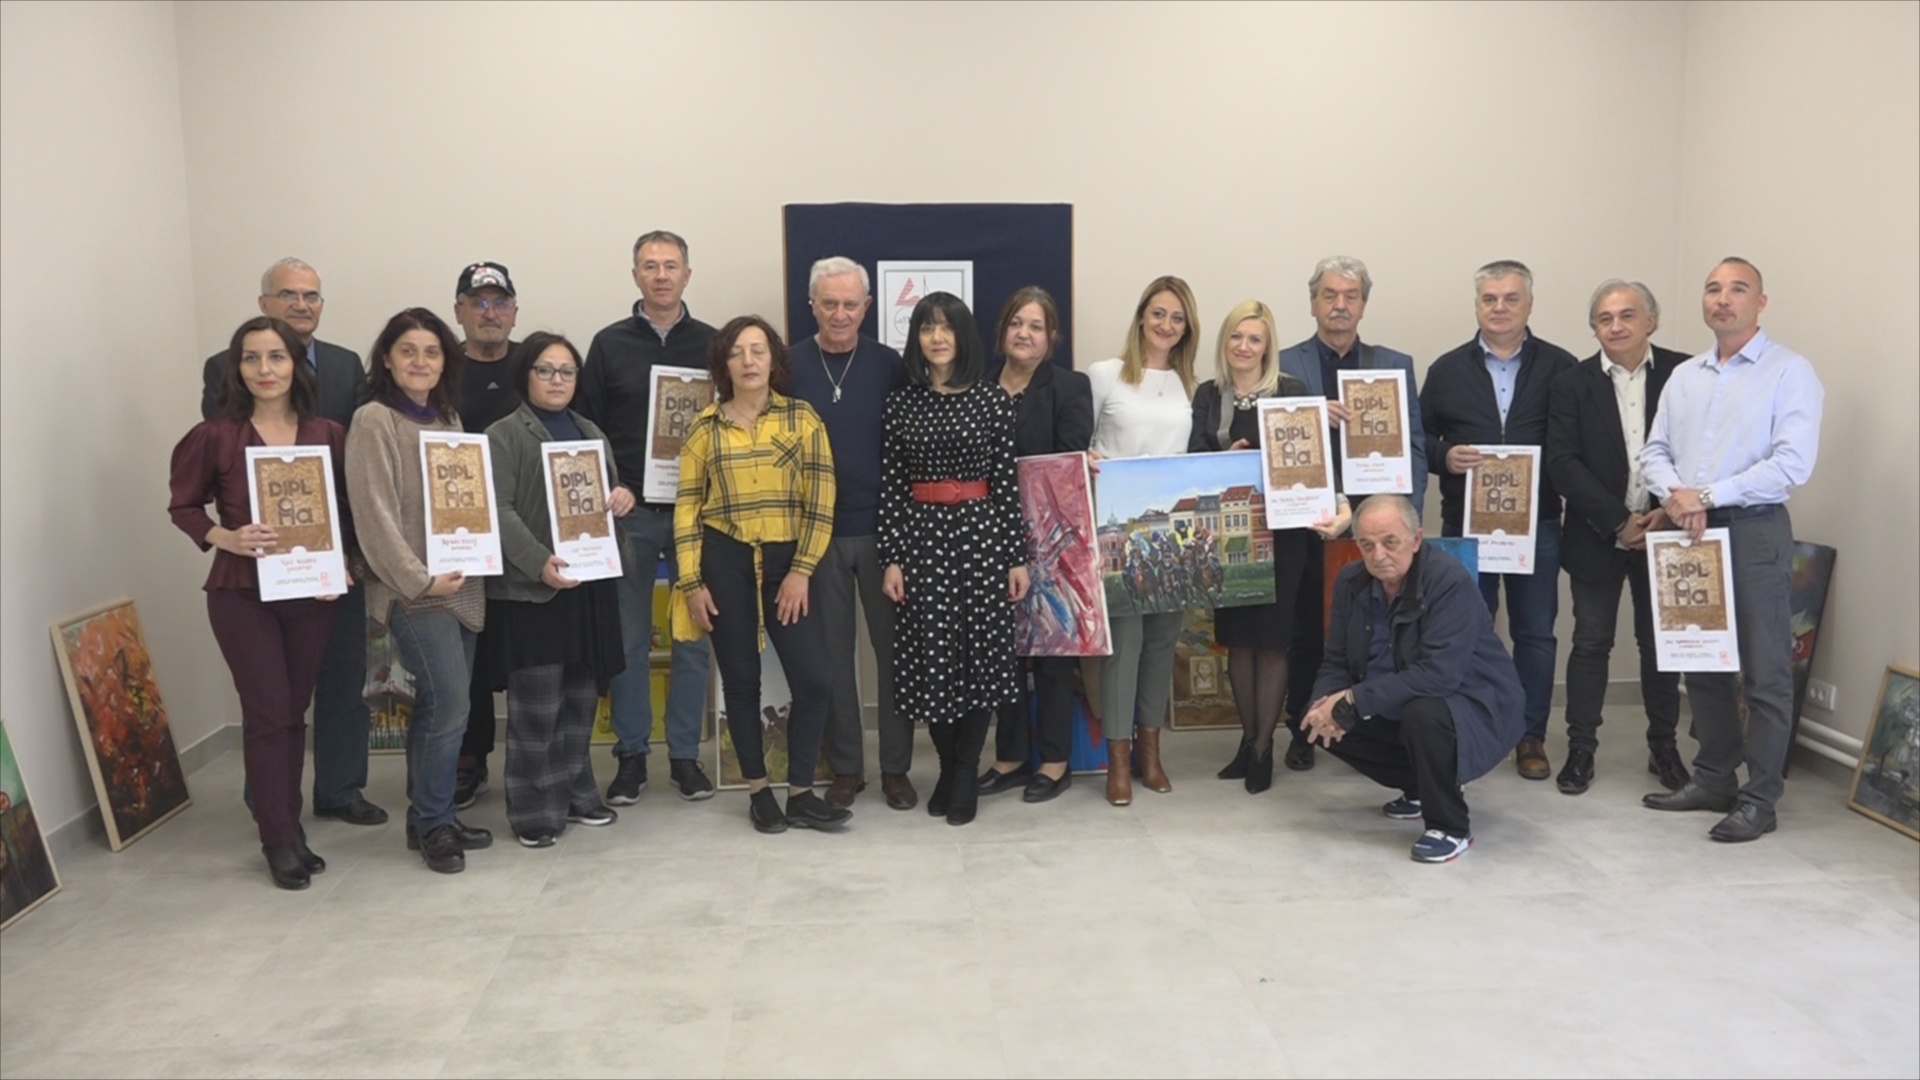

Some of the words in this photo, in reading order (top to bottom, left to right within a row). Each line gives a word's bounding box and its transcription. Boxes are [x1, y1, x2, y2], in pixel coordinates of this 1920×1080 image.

[1353, 397, 1388, 411] DIPL
[1274, 427, 1311, 442] DIPL
[436, 464, 474, 480] DIPL
[560, 472, 593, 488] DIPL
[1482, 473, 1519, 487] DIPL
[268, 480, 313, 497] DIPL
[1666, 562, 1708, 579] DIPL
